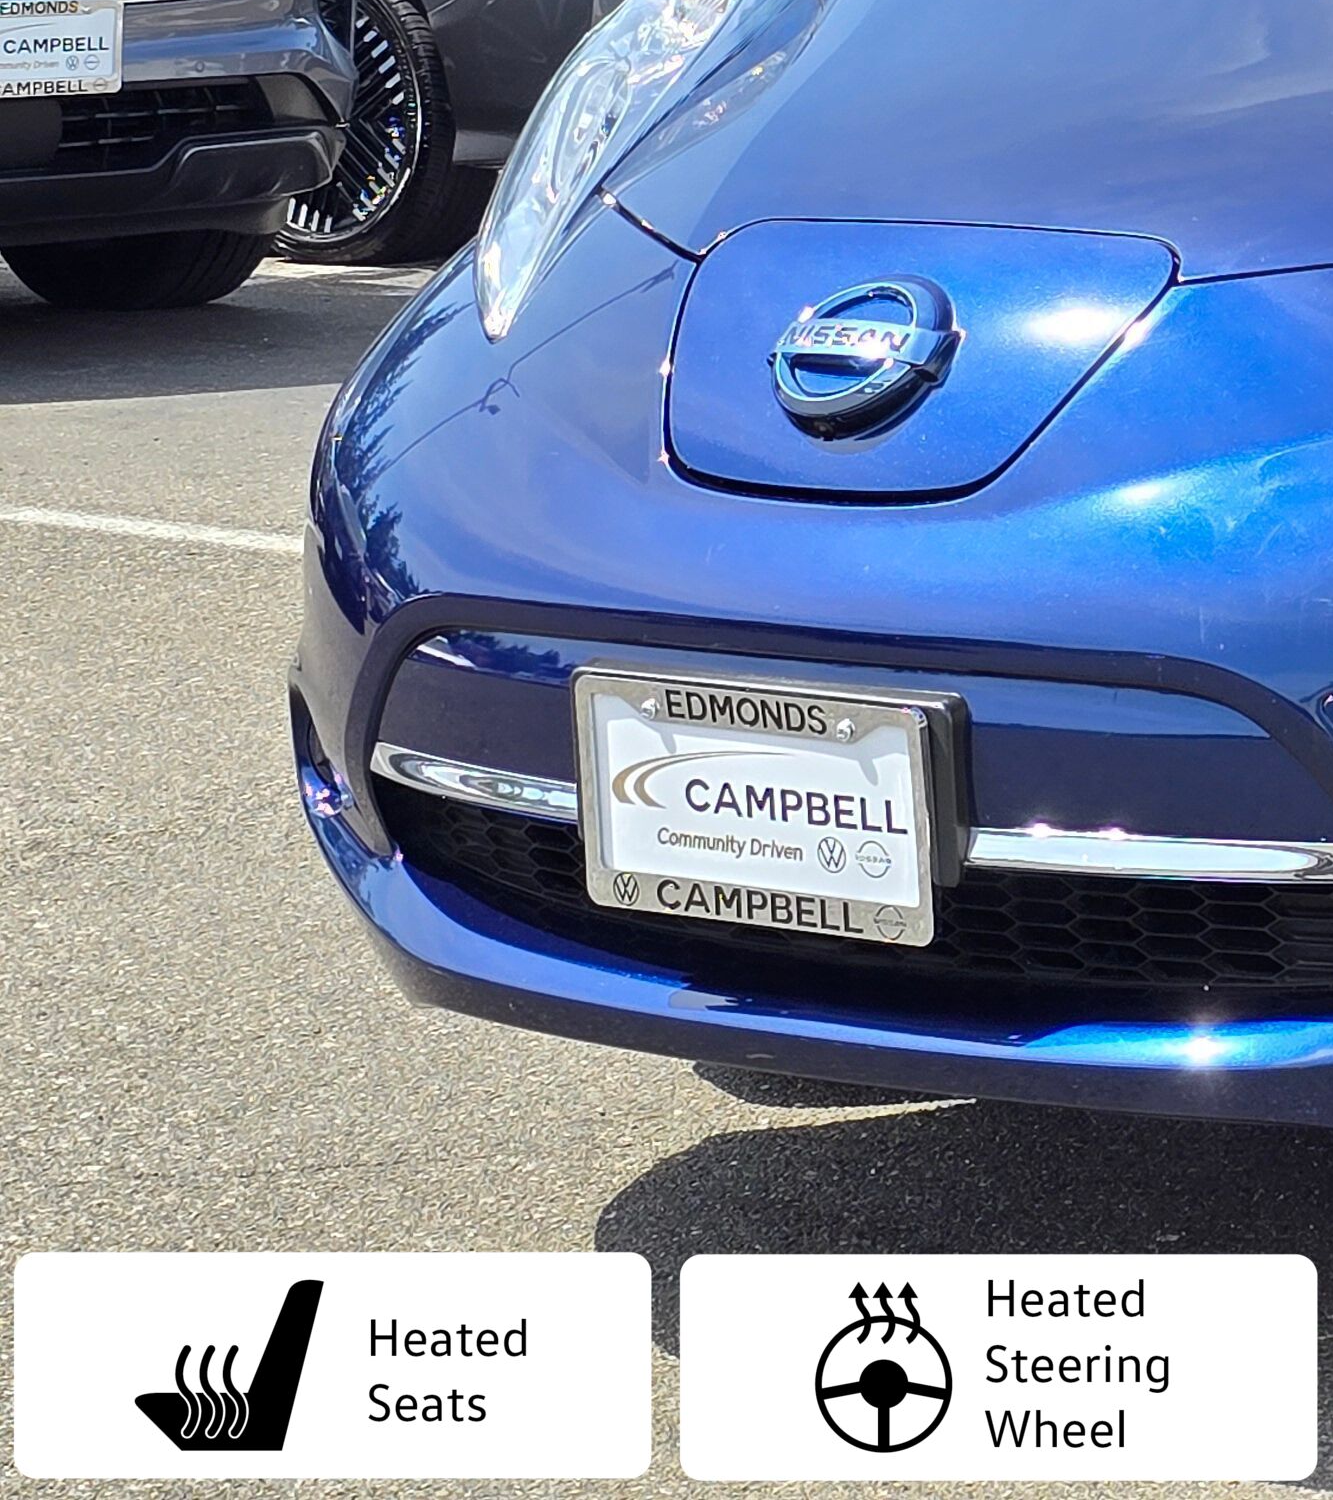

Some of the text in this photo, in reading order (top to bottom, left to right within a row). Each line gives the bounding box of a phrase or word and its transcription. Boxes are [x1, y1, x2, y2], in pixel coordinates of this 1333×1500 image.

[0, 0, 79, 15] EDMONDS
[3, 36, 110, 54] CAMPBELL
[0, 80, 88, 96] AMPBELL
[782, 323, 911, 352] NISSAN
[664, 689, 828, 736] EDMONDS
[685, 778, 908, 835] CAMPBELL
[657, 827, 803, 862] Community Driven
[656, 879, 864, 935] CAMPBELL
